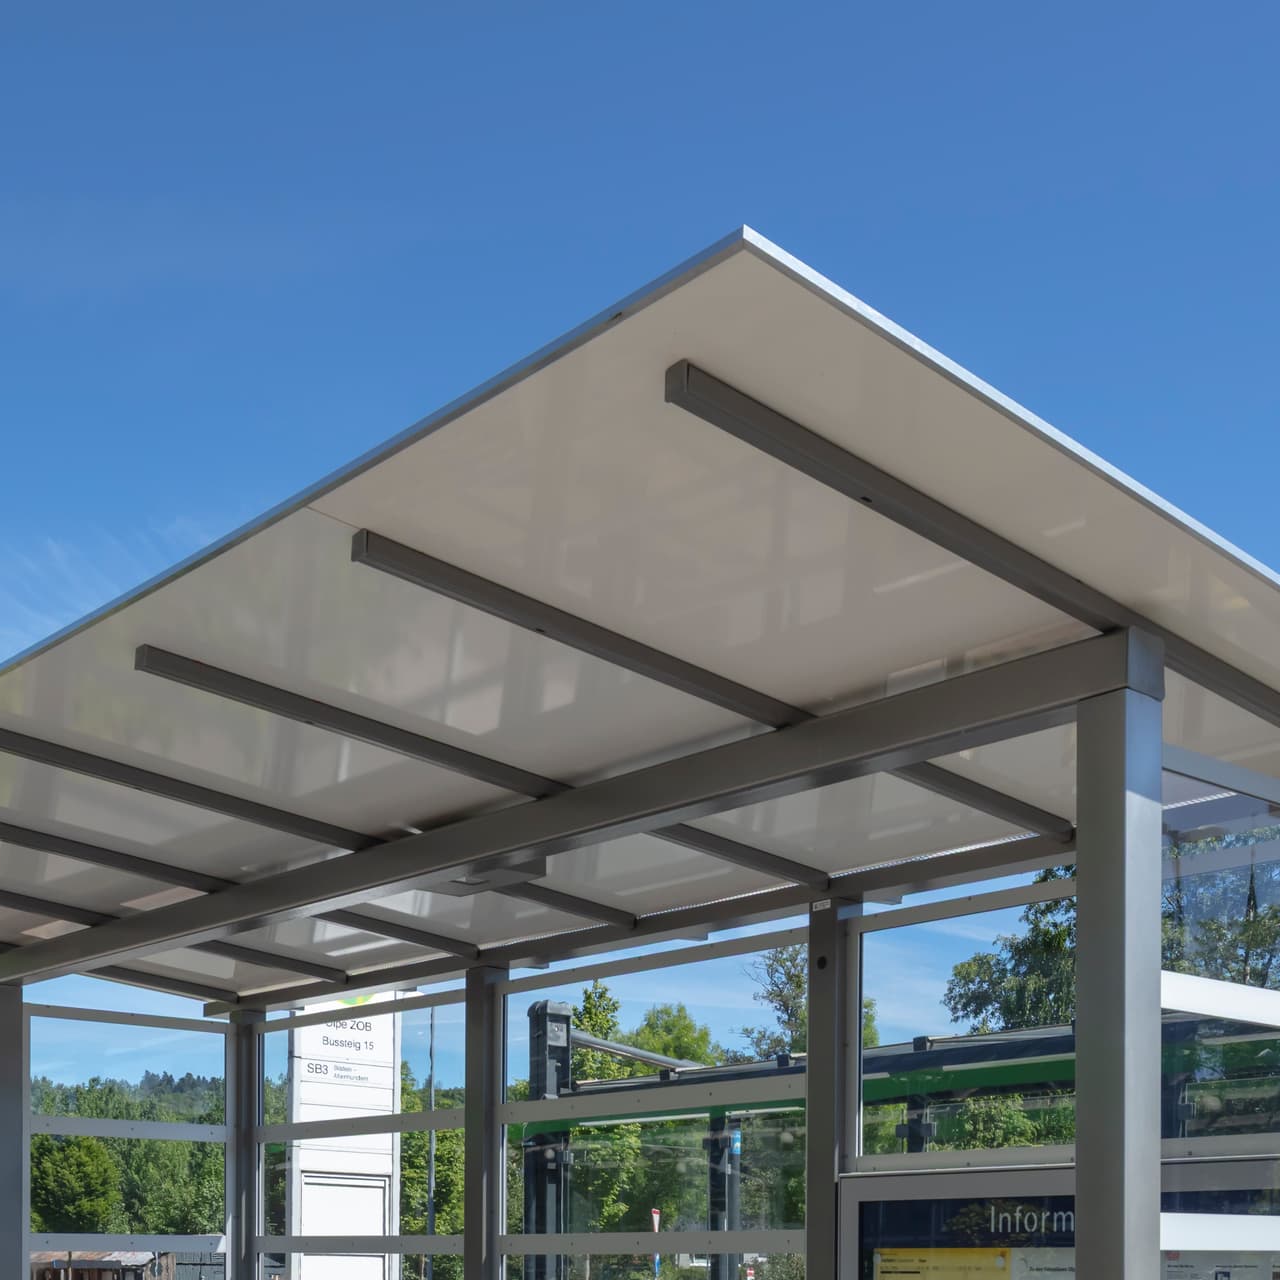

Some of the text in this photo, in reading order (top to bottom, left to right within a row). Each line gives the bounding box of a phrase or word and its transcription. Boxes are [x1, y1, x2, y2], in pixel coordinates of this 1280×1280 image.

[350, 1020, 372, 1032] ZOB
[322, 1036, 374, 1051] Bussteig 15
[307, 1062, 329, 1075] SB3
